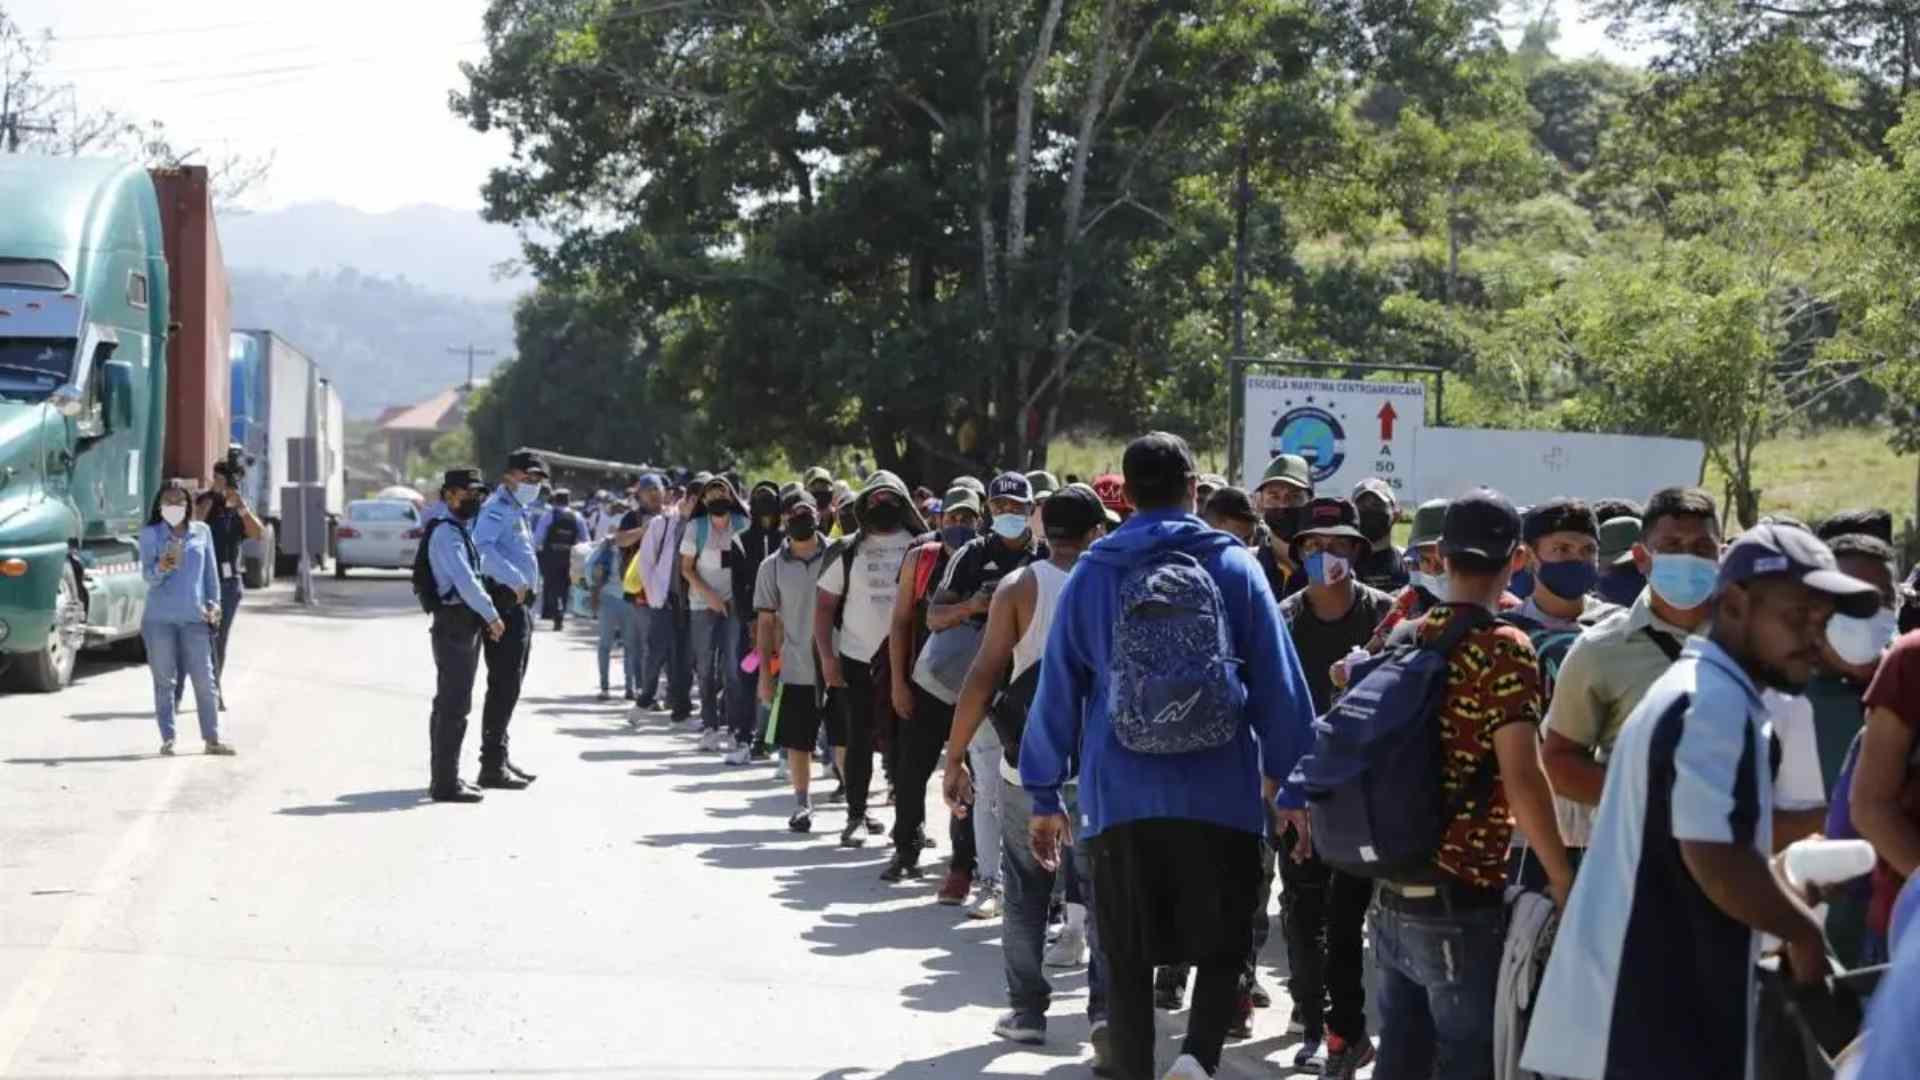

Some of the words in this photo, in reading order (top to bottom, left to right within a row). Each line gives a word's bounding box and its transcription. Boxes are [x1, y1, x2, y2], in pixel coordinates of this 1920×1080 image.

[1248, 379, 1288, 390] ESCUELA
[1337, 382, 1423, 396] CENTROAMERICANA
[1379, 444, 1391, 456] A
[1375, 460, 1394, 473] 50
